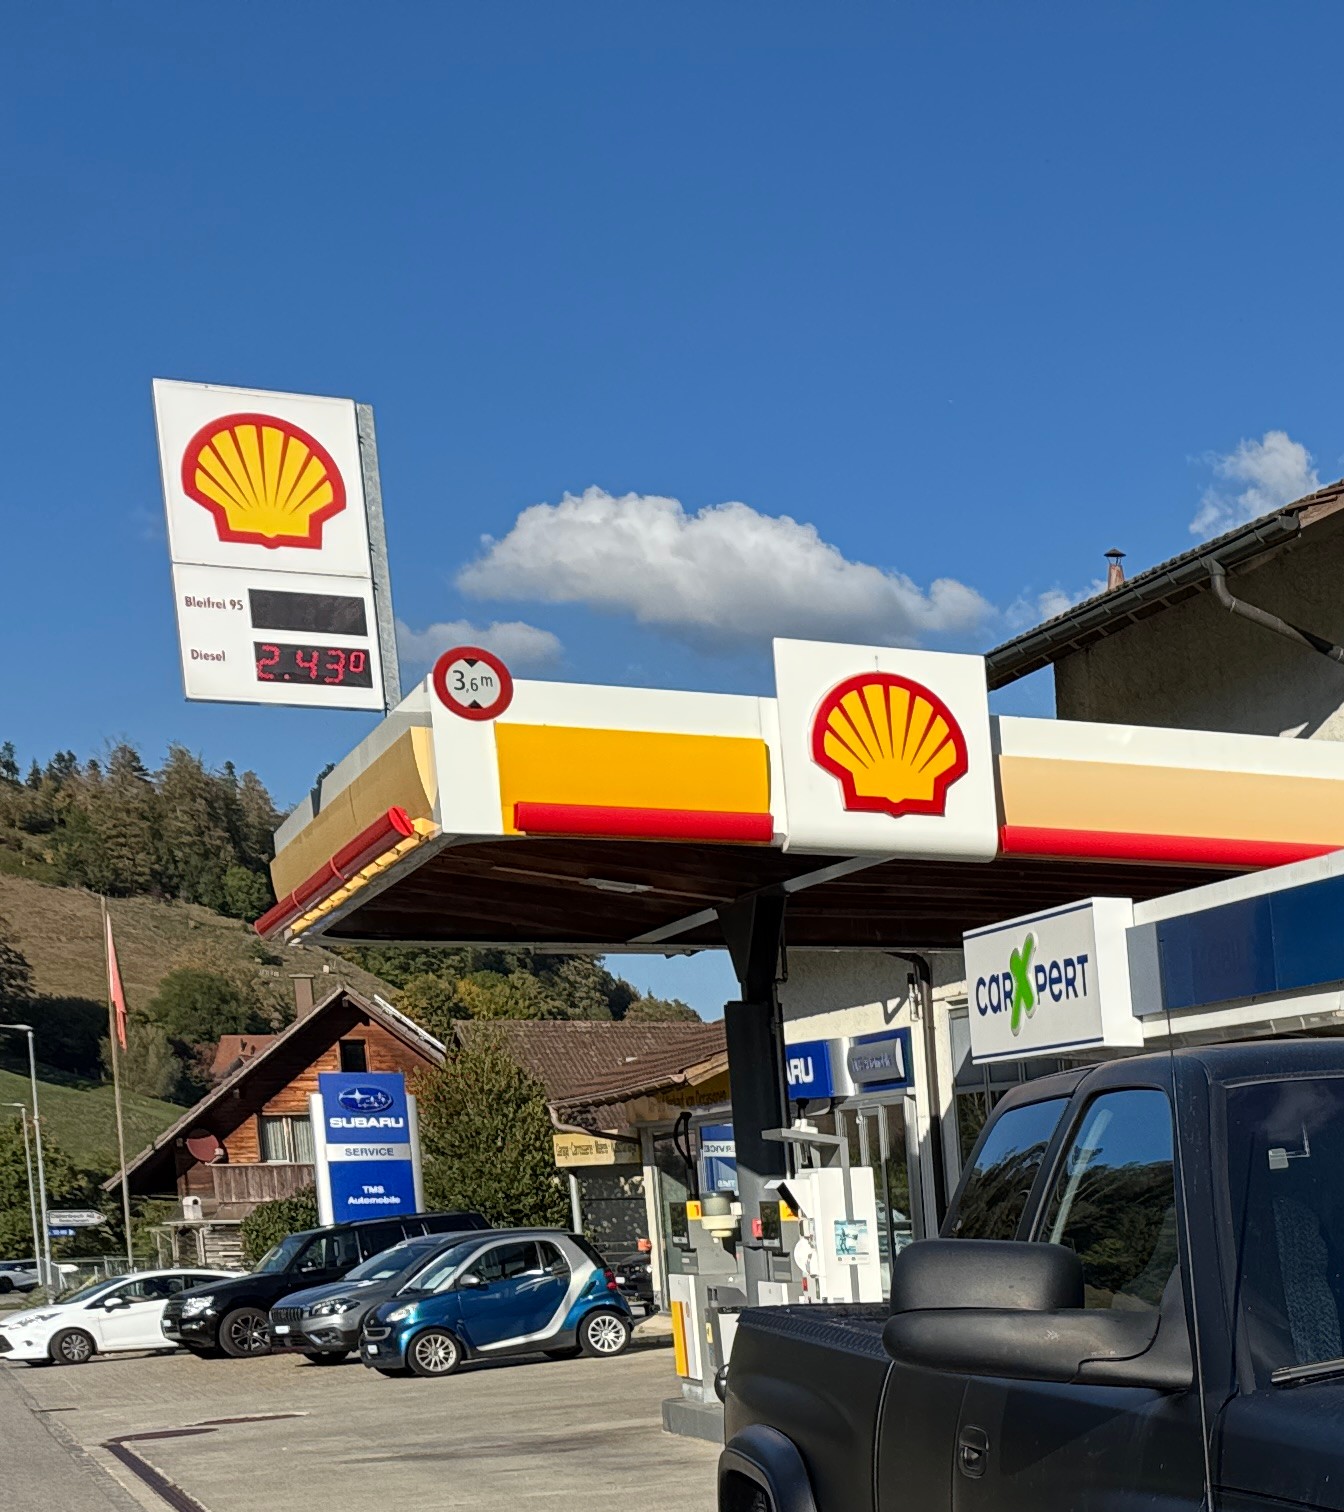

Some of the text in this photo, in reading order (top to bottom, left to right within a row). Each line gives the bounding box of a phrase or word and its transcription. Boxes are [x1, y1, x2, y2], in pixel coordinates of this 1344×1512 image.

[184, 595, 244, 611] Bleifrei 95
[190, 648, 226, 662] Diesel
[329, 1117, 404, 1128] SUBARU
[344, 1147, 394, 1157] SERVICE
[362, 1185, 385, 1194] TMS
[347, 1195, 401, 1205] Automobile
